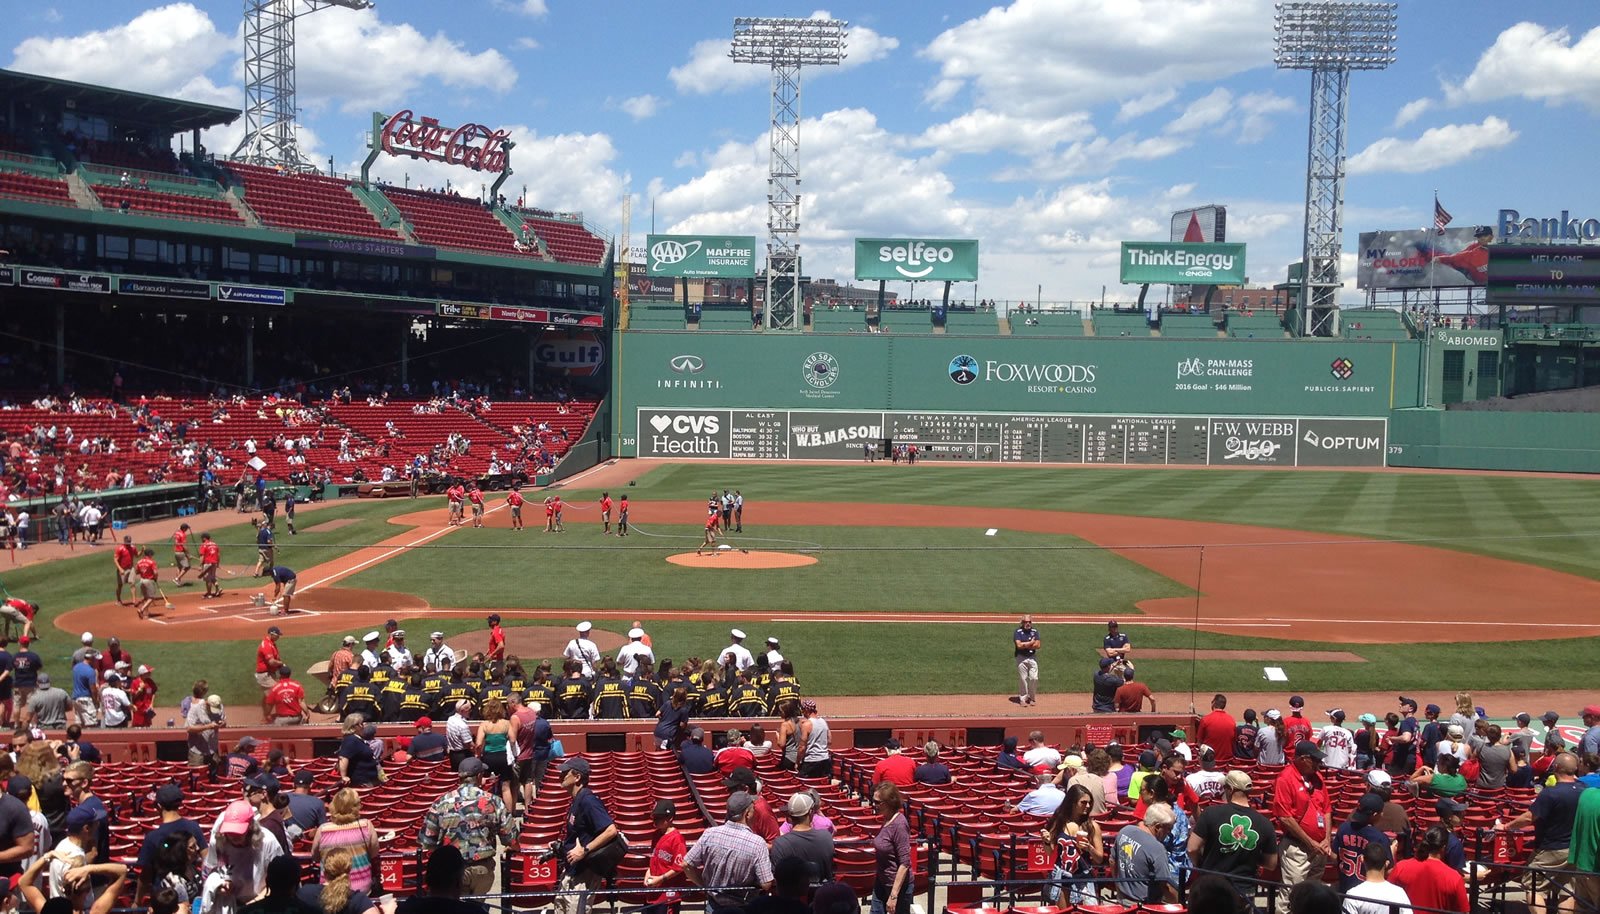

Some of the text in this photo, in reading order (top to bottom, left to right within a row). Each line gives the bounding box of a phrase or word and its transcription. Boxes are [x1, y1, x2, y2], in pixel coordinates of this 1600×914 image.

[381, 110, 512, 172] Coca-Cola
[328, 239, 404, 255] TODAY'S STARTERS
[706, 248, 751, 257] MAPFRE
[1366, 248, 1387, 259] MY
[708, 258, 748, 266] INSURANCE
[1127, 249, 1234, 270] ThinkEnergy
[1531, 255, 1583, 265] WELCOME
[1550, 270, 1564, 280] TO
[133, 284, 166, 293] Barracuda
[628, 283, 639, 291] We
[441, 304, 461, 314] Tribe
[501, 310, 517, 318] Ninety
[554, 316, 577, 324] Safelite
[1446, 336, 1497, 346] ABIOMED
[535, 343, 602, 365] Gulf
[805, 353, 833, 369] RED SOX
[985, 360, 1096, 383] FOXWOODS
[1206, 368, 1253, 377] CHALLENGE
[805, 366, 838, 387] SCHOLARS
[657, 380, 720, 389] INFINITI
[1214, 383, 1227, 391] $46
[1228, 383, 1252, 391] Million
[1027, 386, 1097, 394] RESORT CASINO
[672, 415, 720, 434] CVS
[807, 425, 819, 433] BUT
[1212, 422, 1294, 436] F.W. WEBB
[622, 438, 635, 446] 310
[652, 435, 720, 454] Health
[1321, 437, 1379, 450] OPTUM
[1388, 446, 1403, 454] 379
[389, 680, 405, 689] NAVY
[425, 680, 441, 688] NAVY
[604, 683, 619, 691] NAVY
[354, 686, 370, 695] NAVY
[451, 688, 466, 696] NAVY
[529, 690, 545, 698] NAVY
[742, 689, 757, 697] NAVY
[405, 694, 421, 702] NAVY
[706, 693, 721, 702] NAVY
[1328, 735, 1346, 749] 34
[1343, 834, 1368, 847] BETT
[1034, 854, 1050, 865] 31
[528, 866, 551, 878] 33
